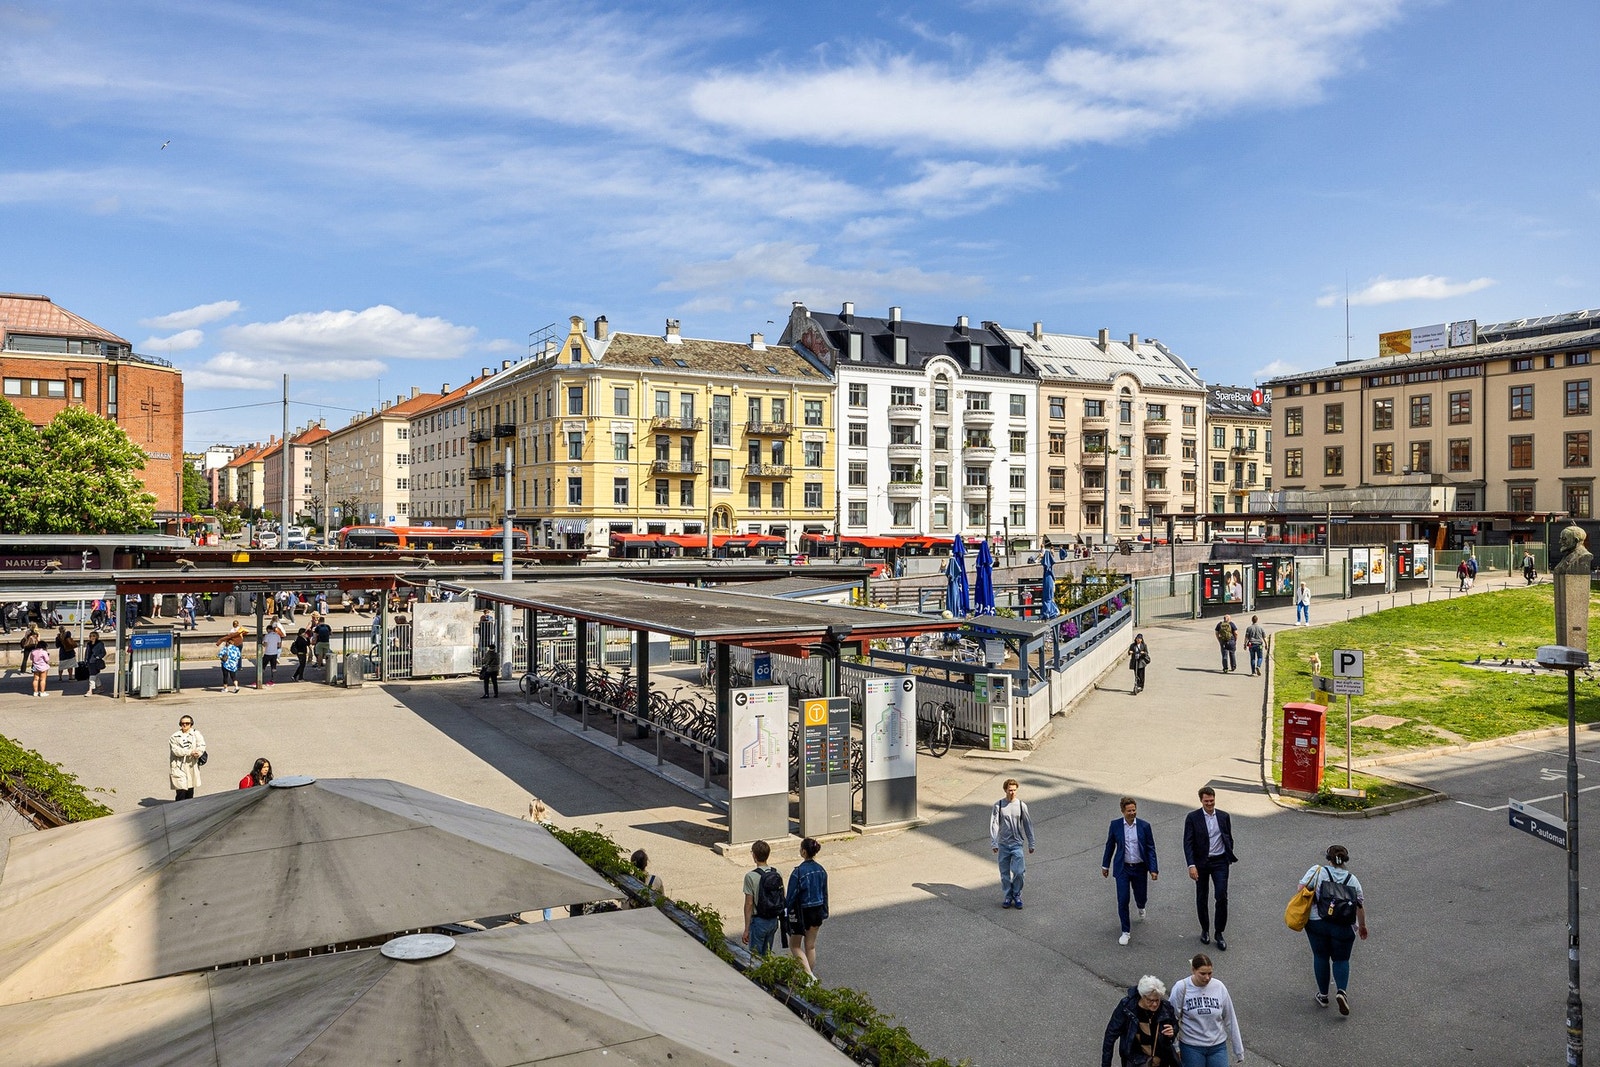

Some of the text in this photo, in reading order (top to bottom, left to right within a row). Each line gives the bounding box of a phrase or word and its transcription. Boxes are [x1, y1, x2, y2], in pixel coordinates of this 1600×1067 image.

[1215, 390, 1252, 402] SpareBank
[1340, 653, 1356, 673] P
[1530, 820, 1566, 846] P-automat
